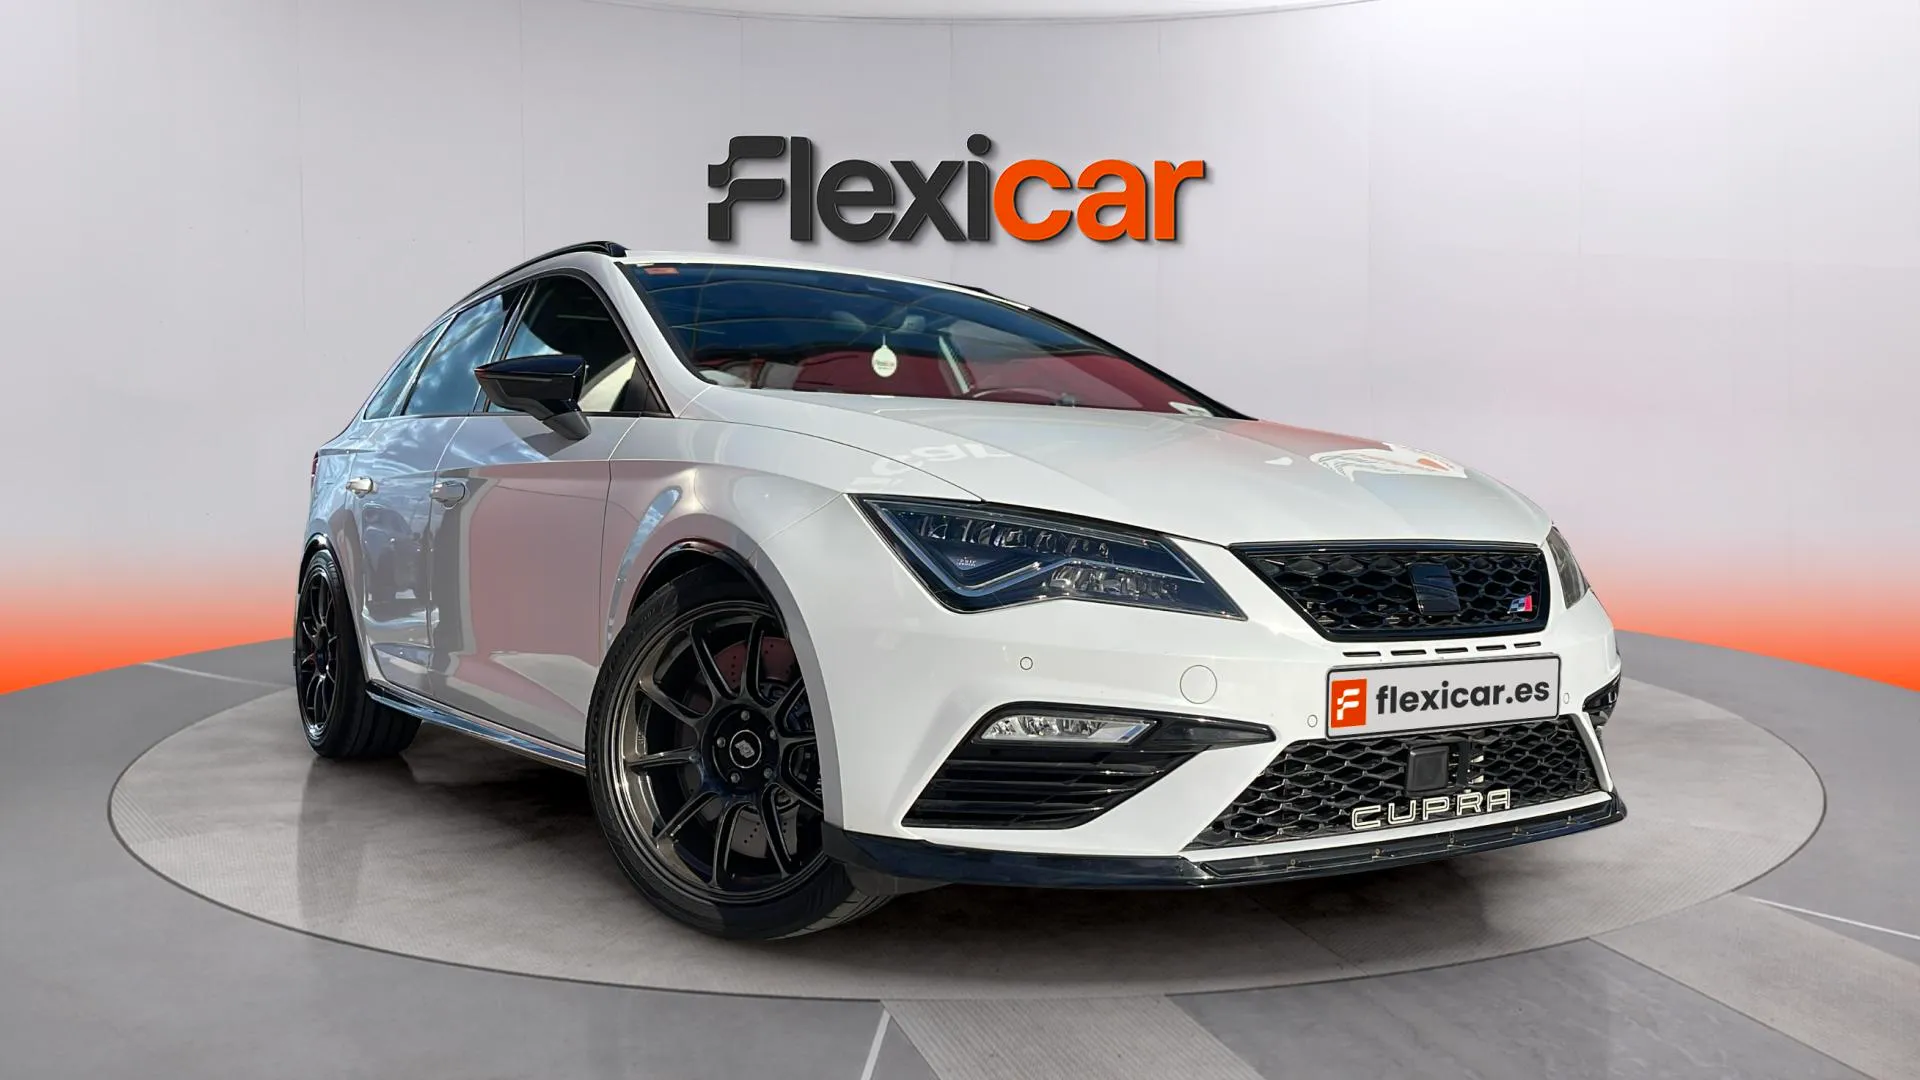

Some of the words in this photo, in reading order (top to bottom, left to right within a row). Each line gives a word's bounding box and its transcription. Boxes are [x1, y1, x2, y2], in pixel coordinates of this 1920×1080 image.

[707, 133, 1205, 242] Flexicar
[1375, 680, 1550, 715] flexicar.es
[1350, 788, 1511, 831] CUPRA
